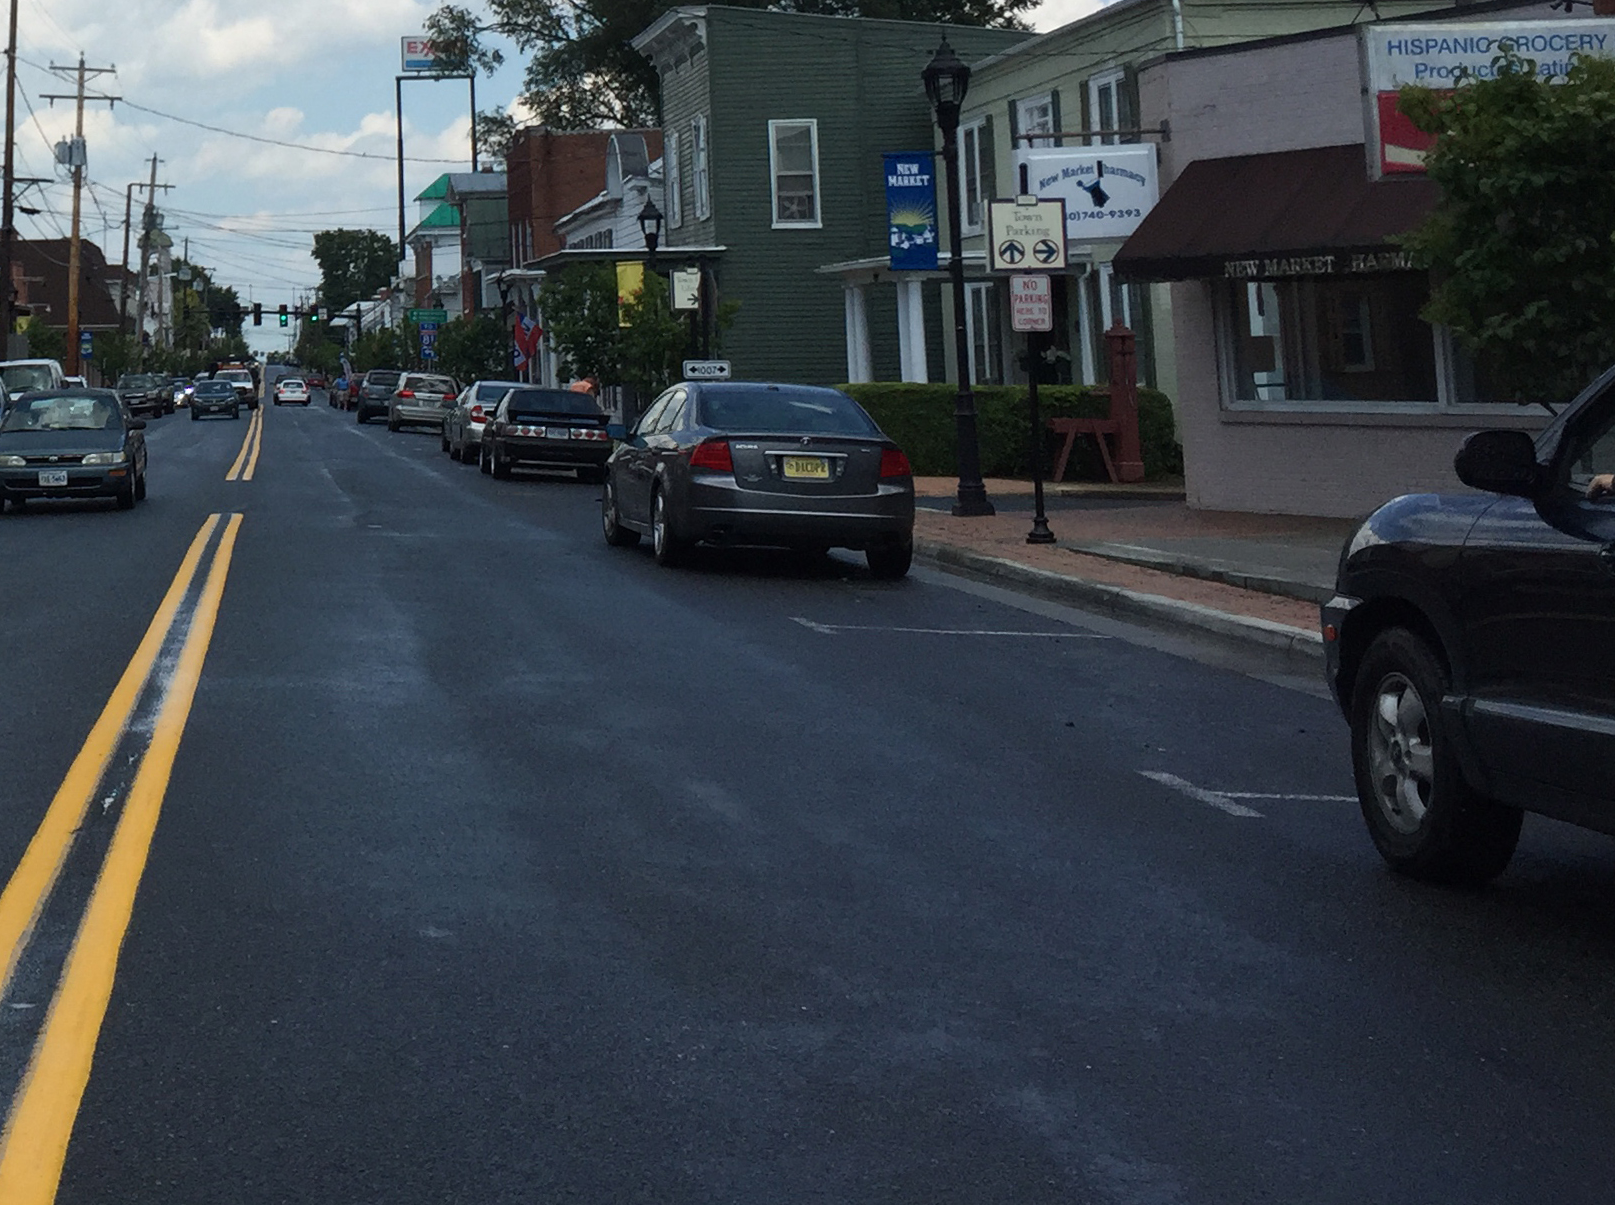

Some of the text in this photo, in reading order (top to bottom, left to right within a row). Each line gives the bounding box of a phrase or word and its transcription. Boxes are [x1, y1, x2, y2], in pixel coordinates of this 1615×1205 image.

[1387, 36, 1491, 56] HISPANIC
[897, 163, 919, 174] NEW
[888, 175, 930, 187] MARKET
[1039, 173, 1059, 190] New
[1061, 164, 1094, 181] Market
[1012, 211, 1043, 222] Town
[1066, 208, 1142, 222] 0)740-9393
[1006, 225, 1051, 237] Parking
[1224, 260, 1260, 278] NEW
[1264, 255, 1337, 277] MARKET
[1022, 280, 1039, 291] NO
[1014, 294, 1048, 305] PARKING
[422, 335, 434, 345] 81
